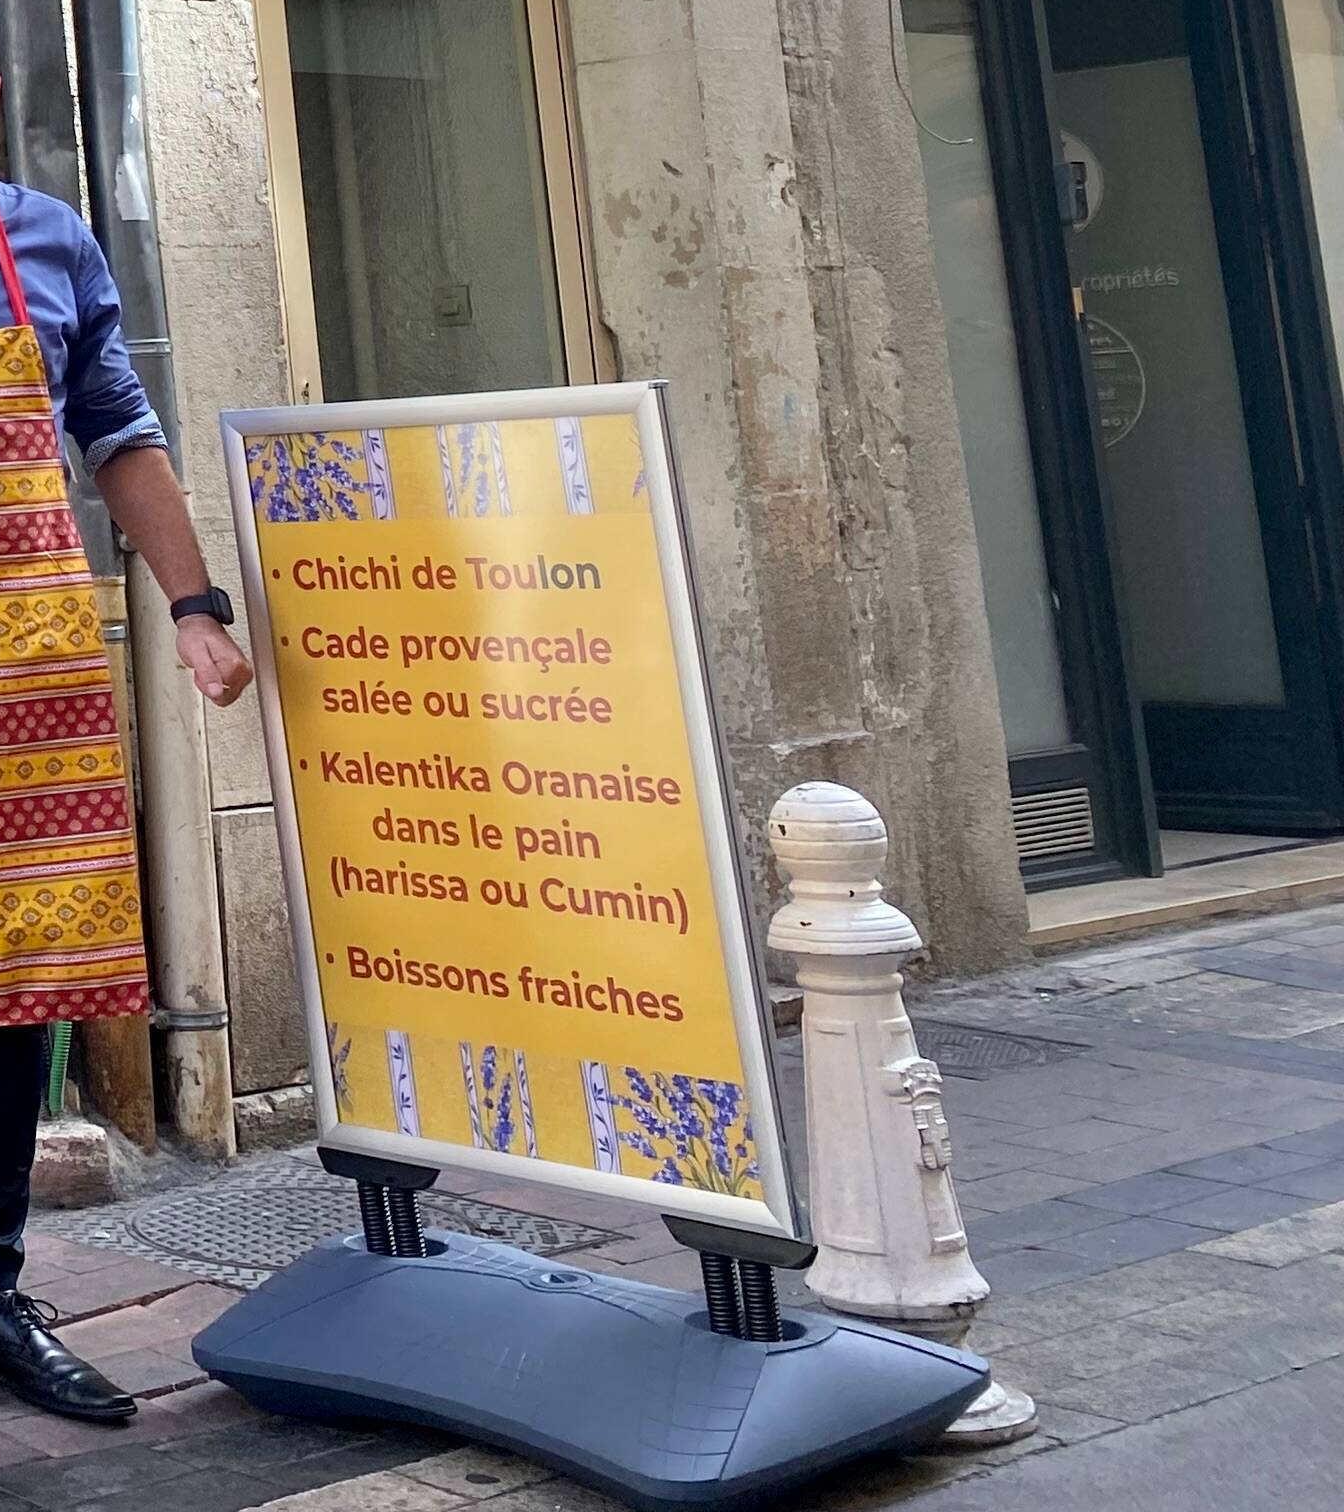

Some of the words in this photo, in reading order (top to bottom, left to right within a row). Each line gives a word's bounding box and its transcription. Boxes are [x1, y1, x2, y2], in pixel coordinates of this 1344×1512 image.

[293, 554, 401, 590] Chichi
[412, 556, 456, 589] de
[464, 555, 600, 590] Toulon
[302, 626, 389, 659] Cade
[400, 629, 611, 673] provençale
[322, 681, 412, 715] salée
[424, 692, 469, 717] ou
[481, 687, 612, 723] sucrée
[320, 751, 491, 792] Kalentika
[502, 761, 680, 805] Oranaise
[373, 808, 460, 846] dans
[469, 814, 503, 850] le
[515, 819, 600, 861] pain
[331, 856, 468, 902] (harissa
[480, 880, 528, 908] ou
[540, 878, 688, 934] Cumin)
[347, 946, 509, 997] Boissons
[518, 966, 683, 1021] fraiches
